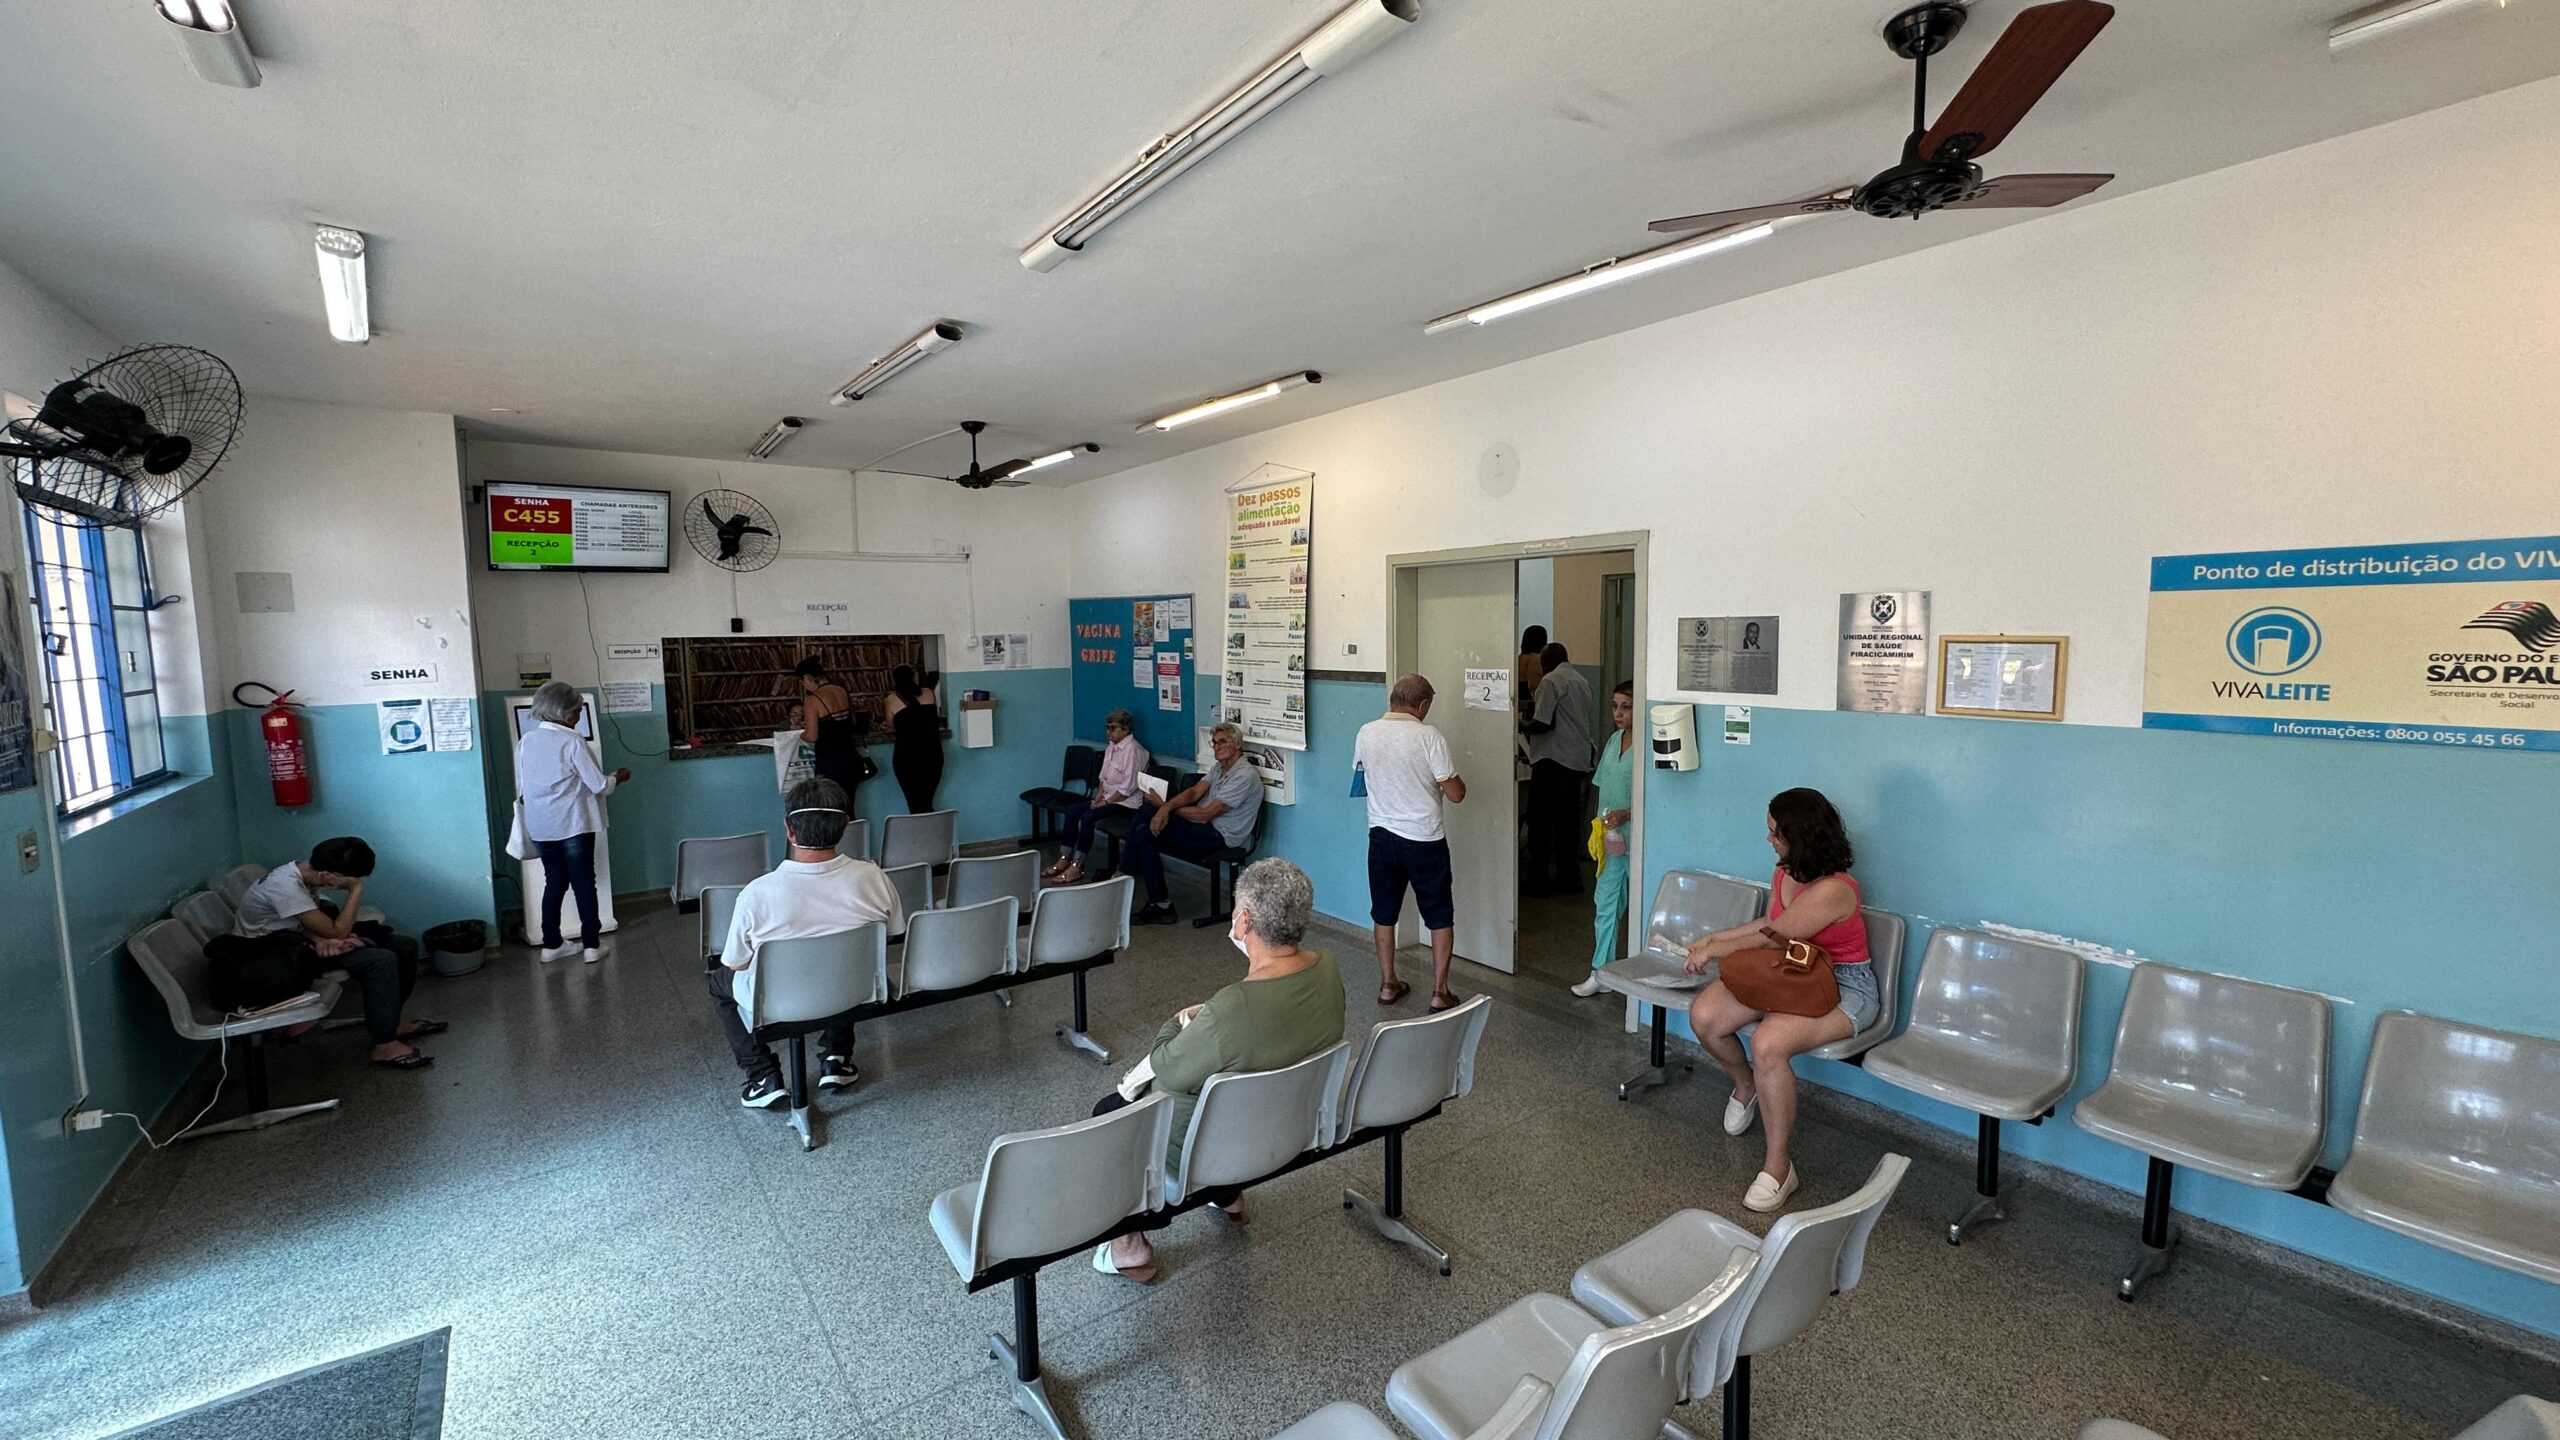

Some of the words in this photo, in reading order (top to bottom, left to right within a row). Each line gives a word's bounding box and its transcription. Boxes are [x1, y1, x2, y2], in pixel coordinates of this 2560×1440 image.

[514, 498, 549, 506] SENHA
[1238, 494, 1256, 507] Dez
[1260, 486, 1301, 507] passos
[503, 508, 560, 524] C455
[1237, 503, 1300, 522] alimentação
[1238, 520, 1265, 531] adequada
[507, 540, 559, 549] RECEPÇÃO
[2193, 564, 2260, 580] Ponto
[2266, 561, 2296, 578] de
[2302, 554, 2459, 577] distribuição
[2467, 551, 2506, 571] do
[806, 603, 848, 612] RECEPÇÃO
[825, 615, 831, 626] 1
[1077, 624, 1121, 639] VACINA
[1874, 641, 1902, 650] SAÚDE
[1080, 648, 1117, 664] GRIPE
[1850, 651, 1914, 659] PIRACICAMIRIM
[2428, 653, 2512, 663] GOVERNO
[2516, 654, 2544, 663] DO
[370, 669, 429, 681] SENHA
[1466, 671, 1508, 682] RECEPÇÃO
[2426, 661, 2498, 683] SÃO
[1483, 686, 1491, 702] 2
[2212, 681, 2331, 702] VIVALEITE
[2430, 689, 2487, 699] Secretaria
[2490, 691, 2505, 699] de
[2500, 700, 2535, 709] Social
[2273, 722, 2380, 739] Informações:
[2385, 728, 2428, 741] 0800
[2433, 731, 2467, 744] 055
[2471, 733, 2495, 746] 45
[2501, 733, 2525, 746] 66
